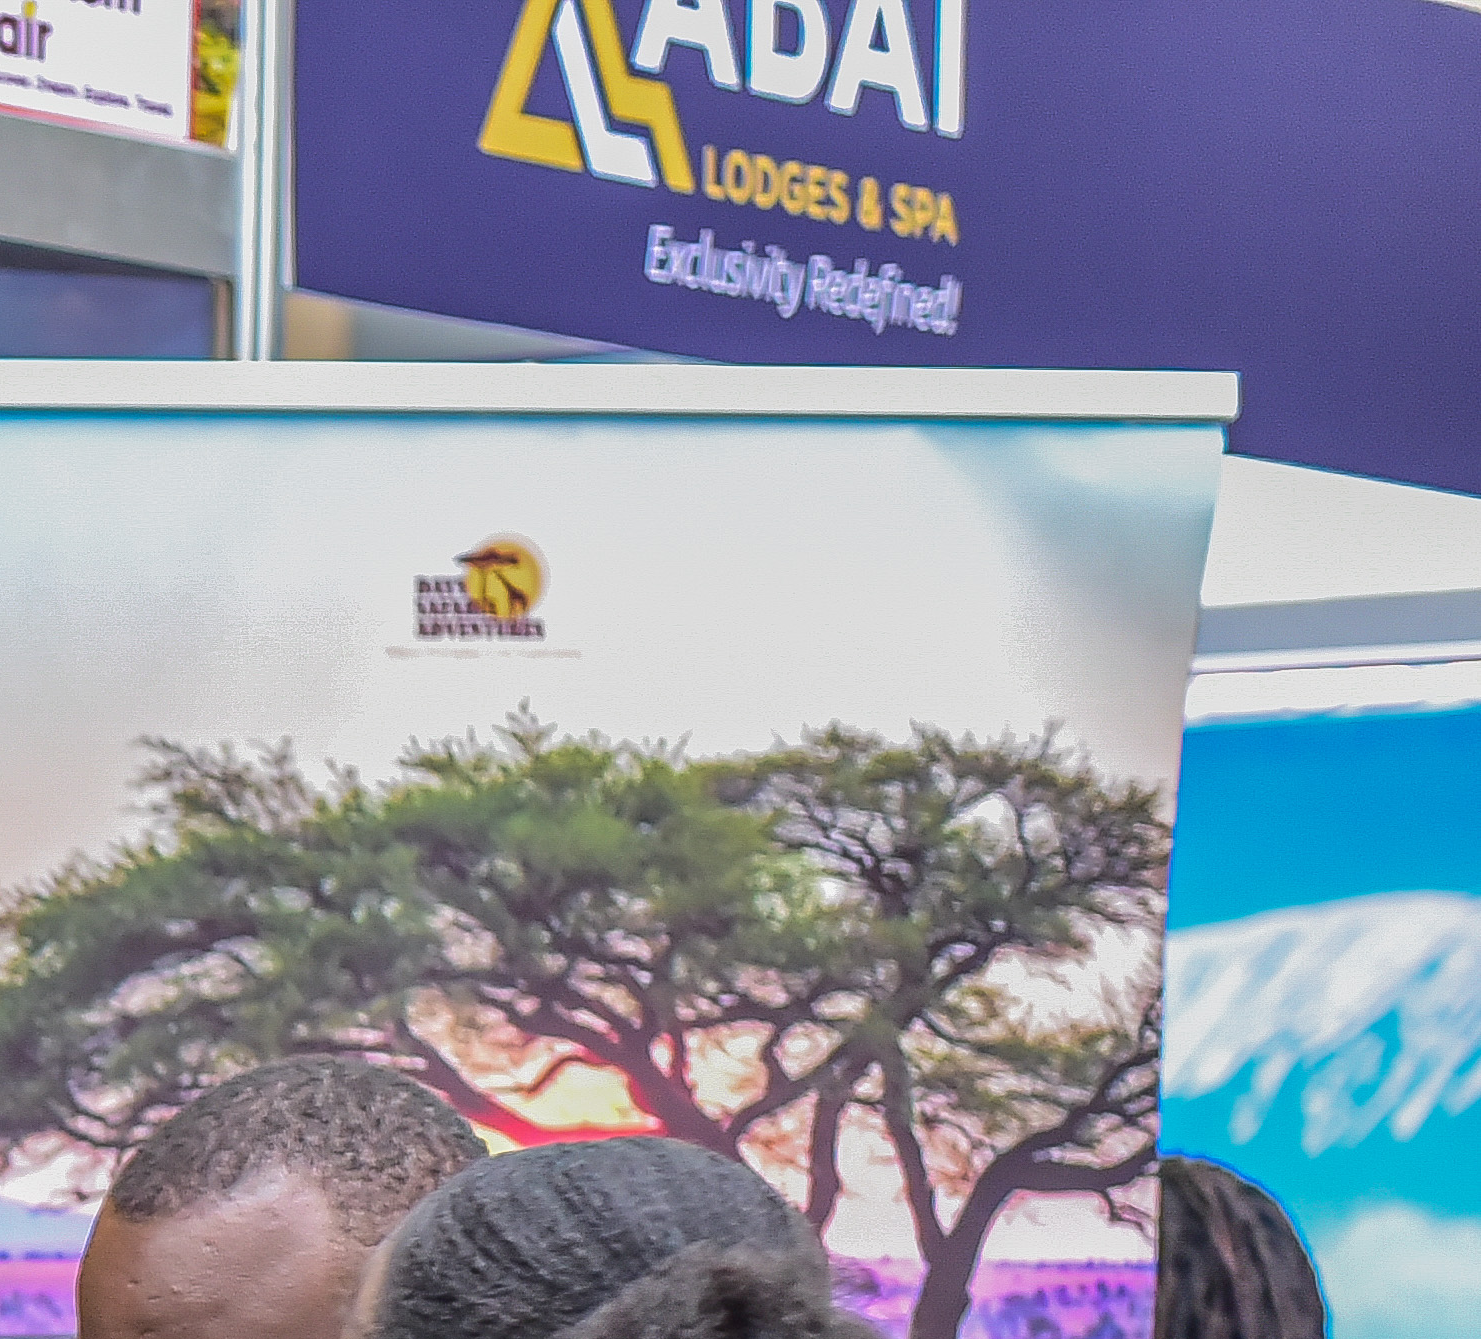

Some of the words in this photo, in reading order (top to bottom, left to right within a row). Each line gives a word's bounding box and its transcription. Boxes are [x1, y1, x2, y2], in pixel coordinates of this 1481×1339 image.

[702, 144, 850, 224] LODGES
[856, 177, 882, 231] &
[889, 181, 959, 246] SPA
[644, 224, 806, 319] Exclusivity
[806, 254, 963, 336] Redefined!
